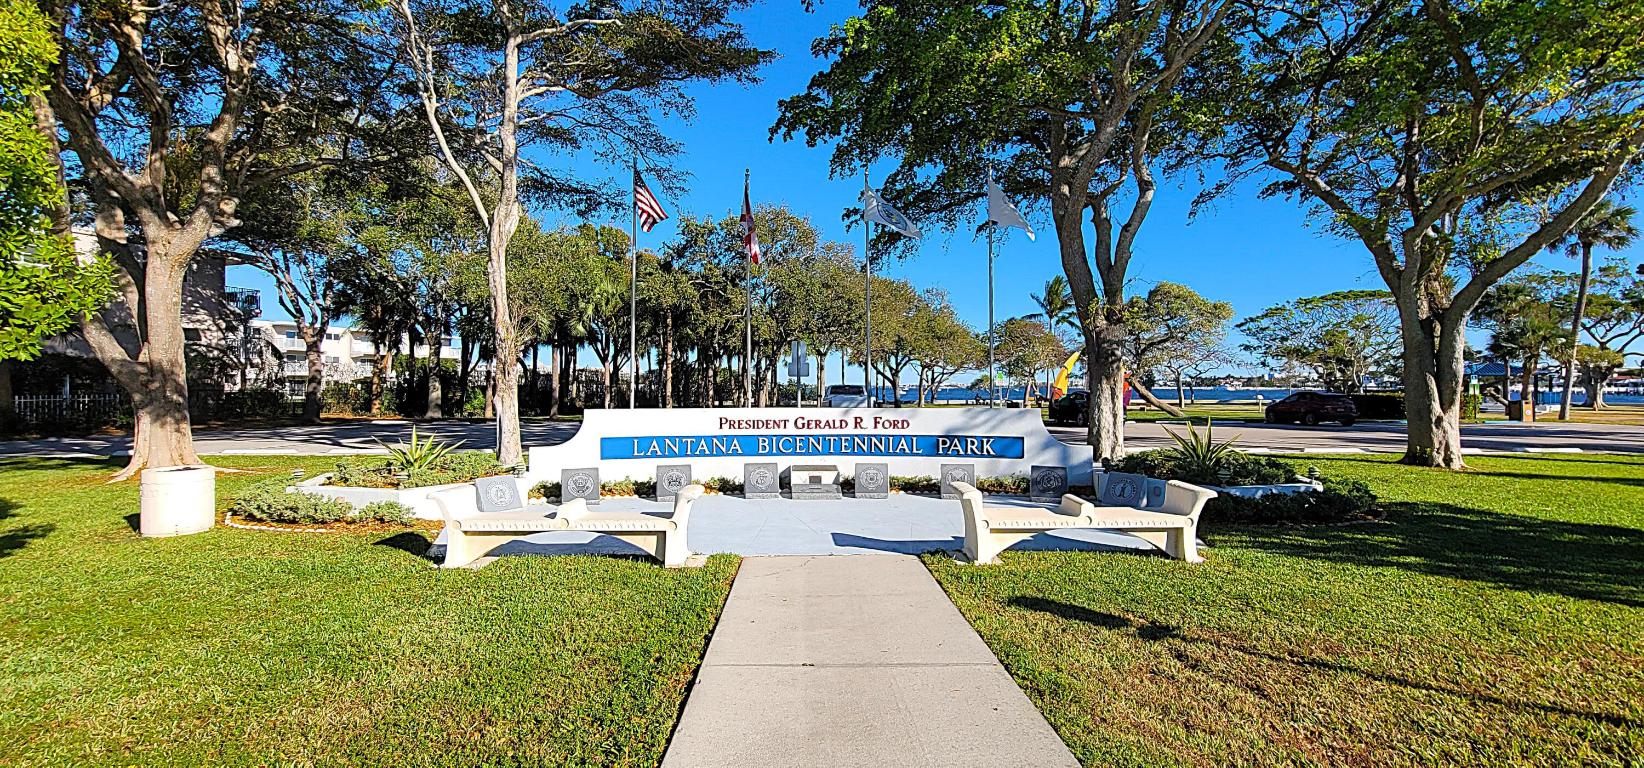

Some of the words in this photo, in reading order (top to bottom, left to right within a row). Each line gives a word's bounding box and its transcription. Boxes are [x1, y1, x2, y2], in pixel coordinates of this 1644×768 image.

[633, 438, 743, 456] LANTANA
[757, 437, 923, 455] BICENTENNIAL
[937, 437, 996, 456] PARK
